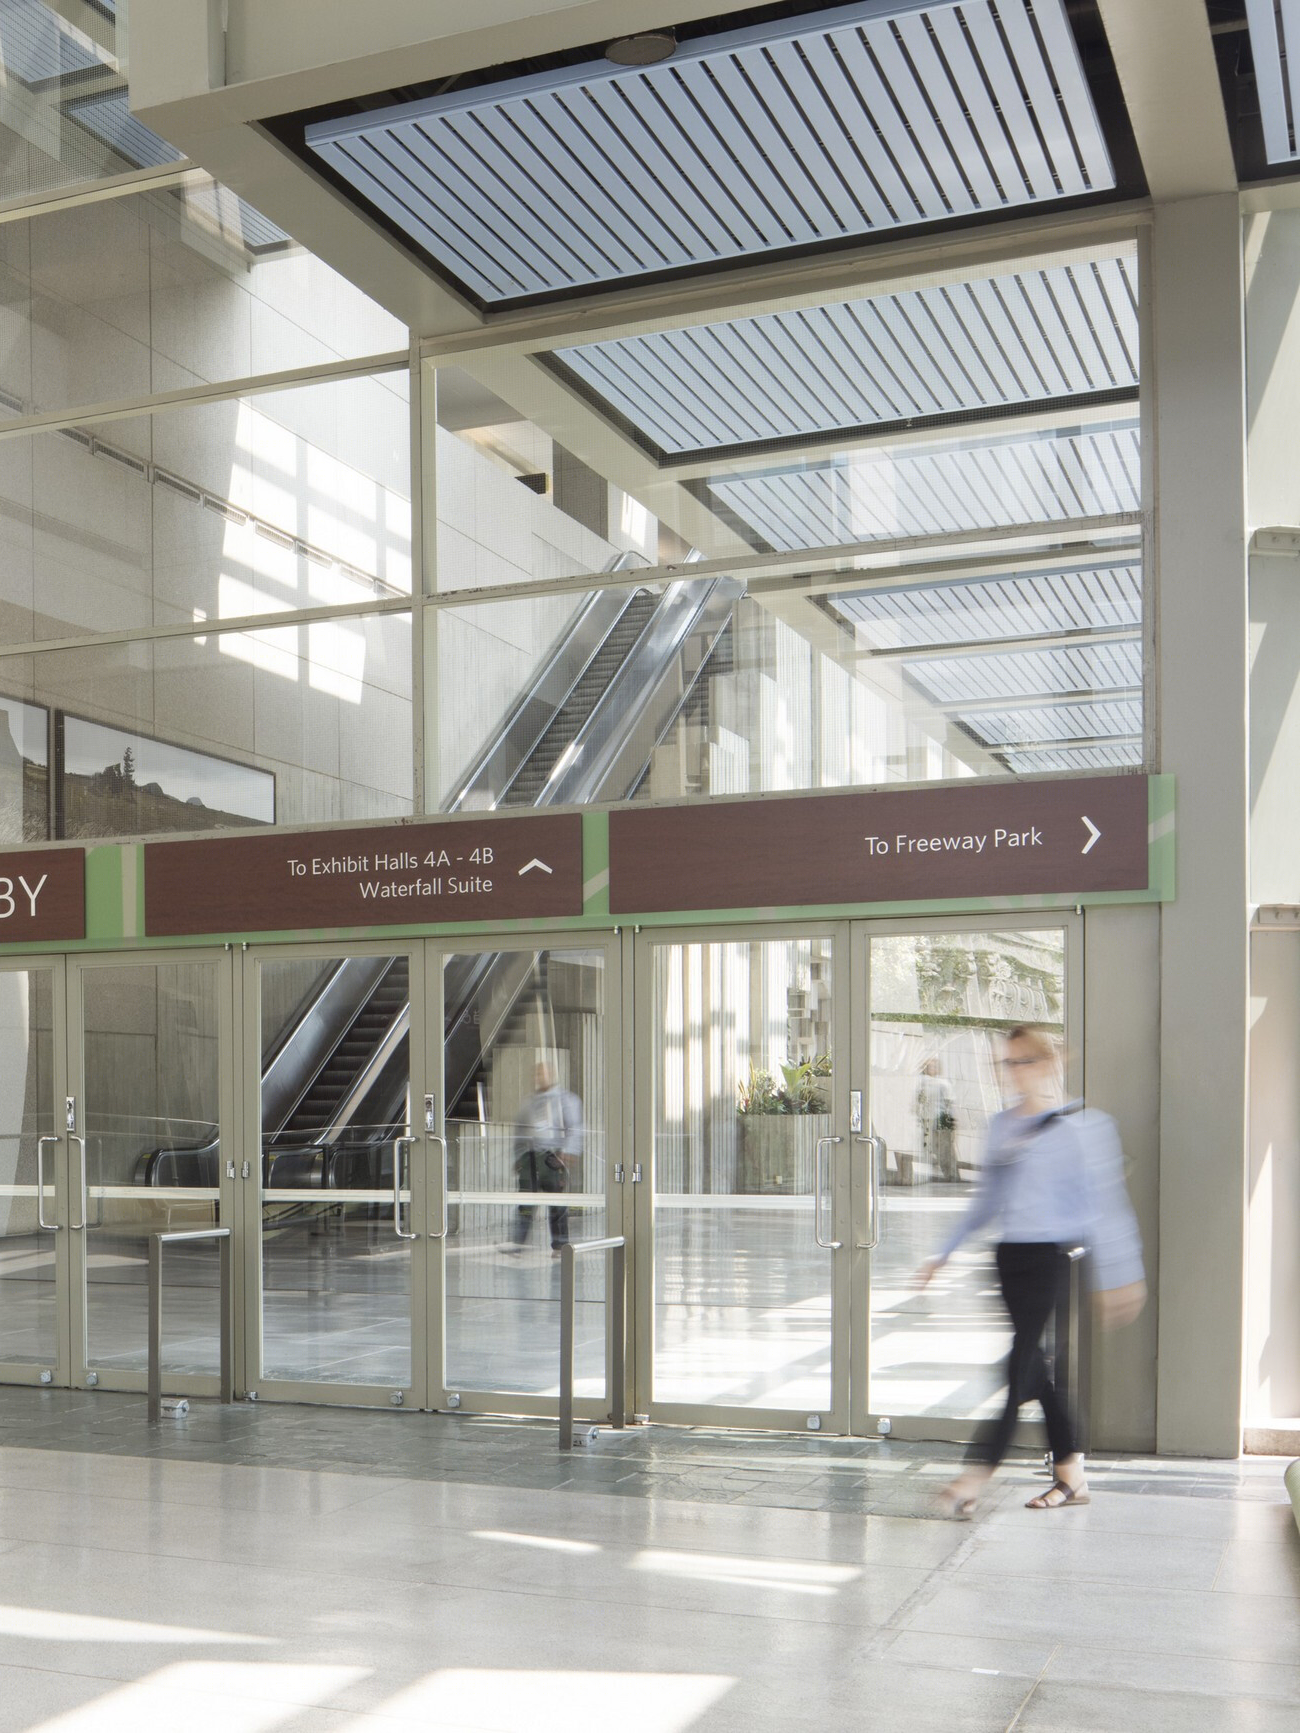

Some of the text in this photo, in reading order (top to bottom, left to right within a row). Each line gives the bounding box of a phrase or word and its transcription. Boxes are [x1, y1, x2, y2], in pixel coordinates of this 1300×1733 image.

[864, 826, 1043, 855] To Freeway Park
[287, 859, 307, 876] To
[312, 855, 369, 875] Exhibit
[375, 852, 418, 871] Halls
[423, 850, 451, 867] 4A
[469, 847, 494, 865] 4B
[359, 876, 493, 899] Waterfall Suite
